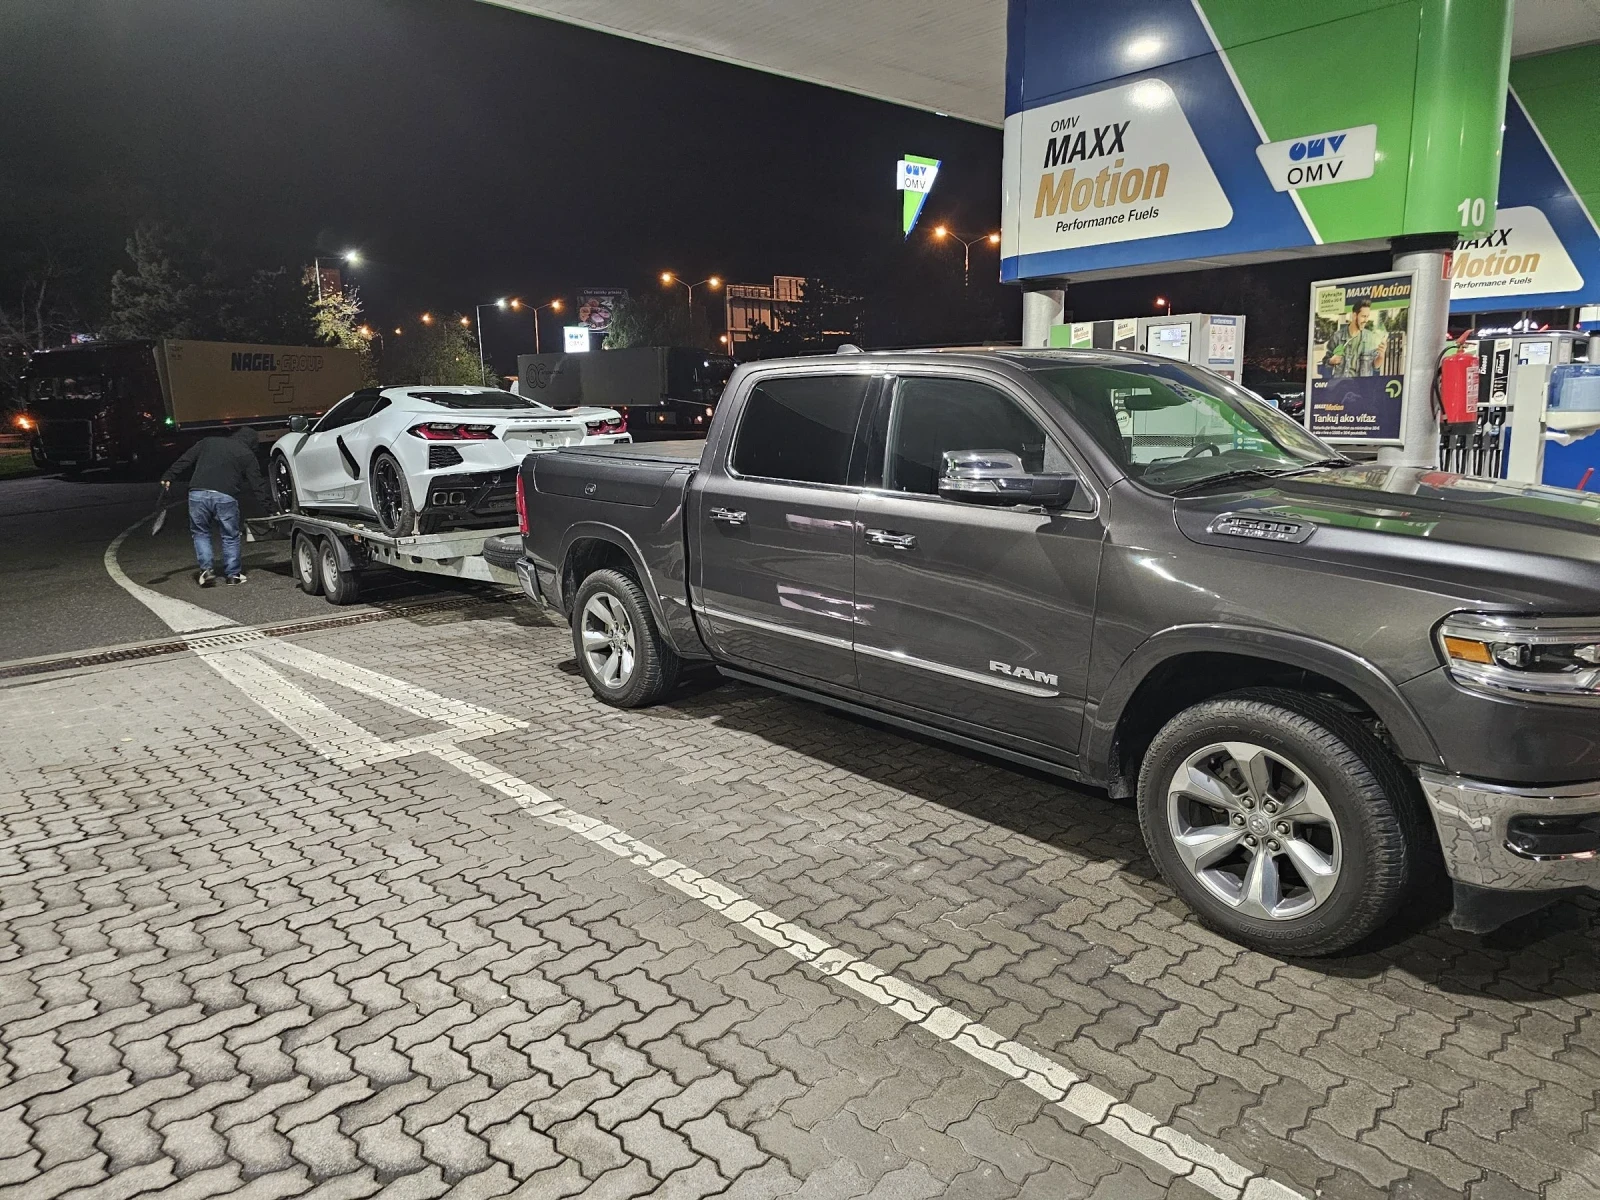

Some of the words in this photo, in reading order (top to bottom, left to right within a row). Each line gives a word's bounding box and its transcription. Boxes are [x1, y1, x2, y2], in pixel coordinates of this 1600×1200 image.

[1050, 115, 1080, 133] OMV
[1043, 120, 1131, 168] MAXX
[905, 178, 926, 190] OMV
[1287, 160, 1343, 185] OMV
[1034, 158, 1170, 219] Motion
[1056, 213, 1125, 233] Performance
[1128, 206, 1160, 222] Fuels
[1457, 197, 1486, 228] 10
[1453, 279, 1507, 290] Performance
[1509, 277, 1533, 286] Fuels
[1479, 354, 1488, 375] Diesel
[1497, 353, 1505, 375] Diesel
[1313, 413, 1339, 425] Tankuj
[1339, 413, 1355, 423] ako
[989, 659, 1059, 687] RAM
